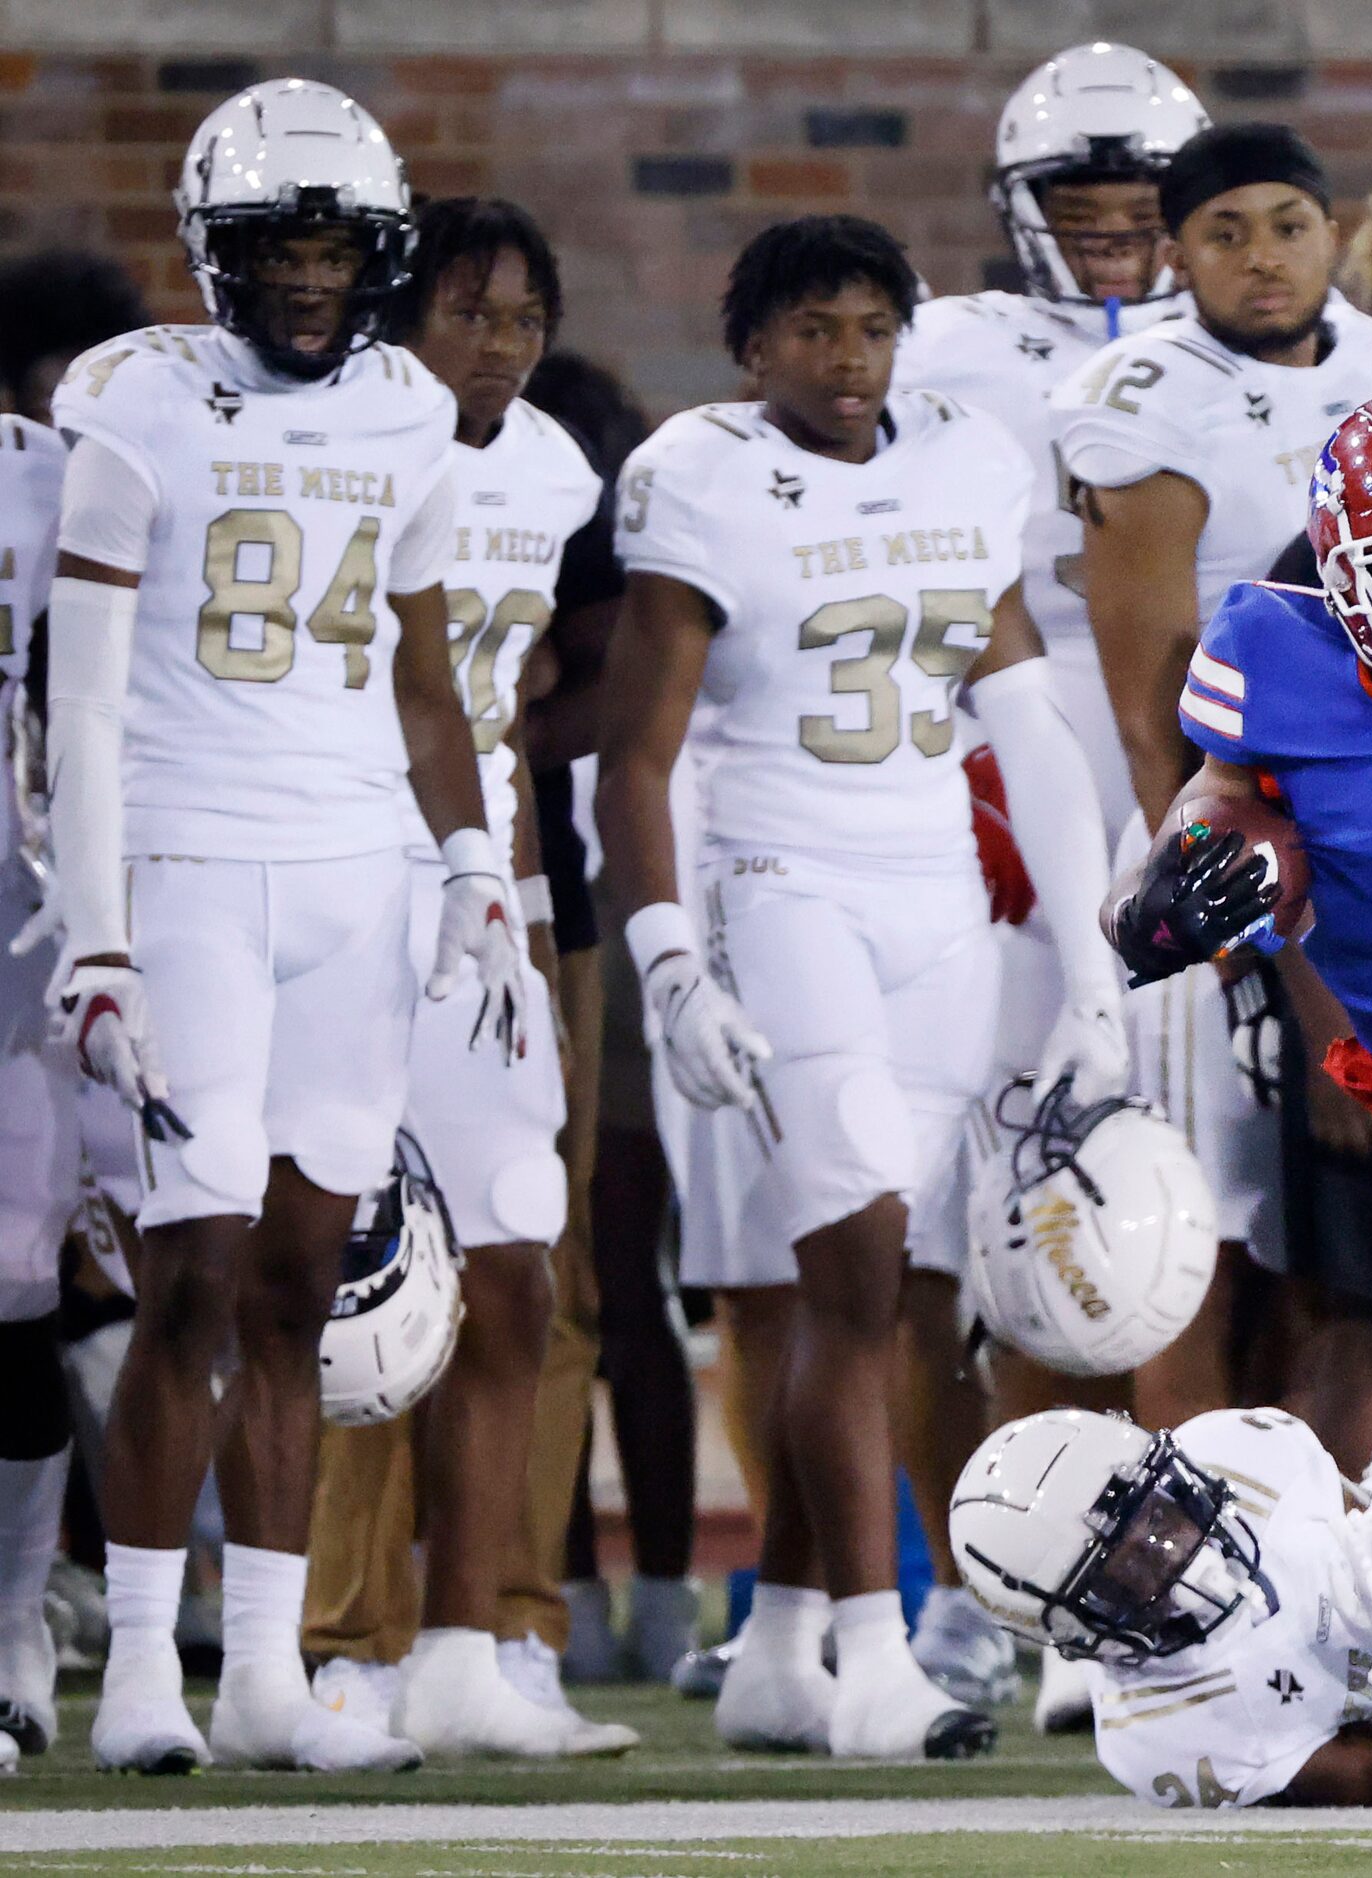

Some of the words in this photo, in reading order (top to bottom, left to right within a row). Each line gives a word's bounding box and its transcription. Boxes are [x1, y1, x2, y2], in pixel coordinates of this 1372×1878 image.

[211, 461, 284, 497] THE
[300, 466, 396, 508] MECCA
[195, 508, 382, 691] 84
[792, 536, 868, 579] THE
[881, 526, 989, 565] MECCA
[798, 587, 994, 765] 35
